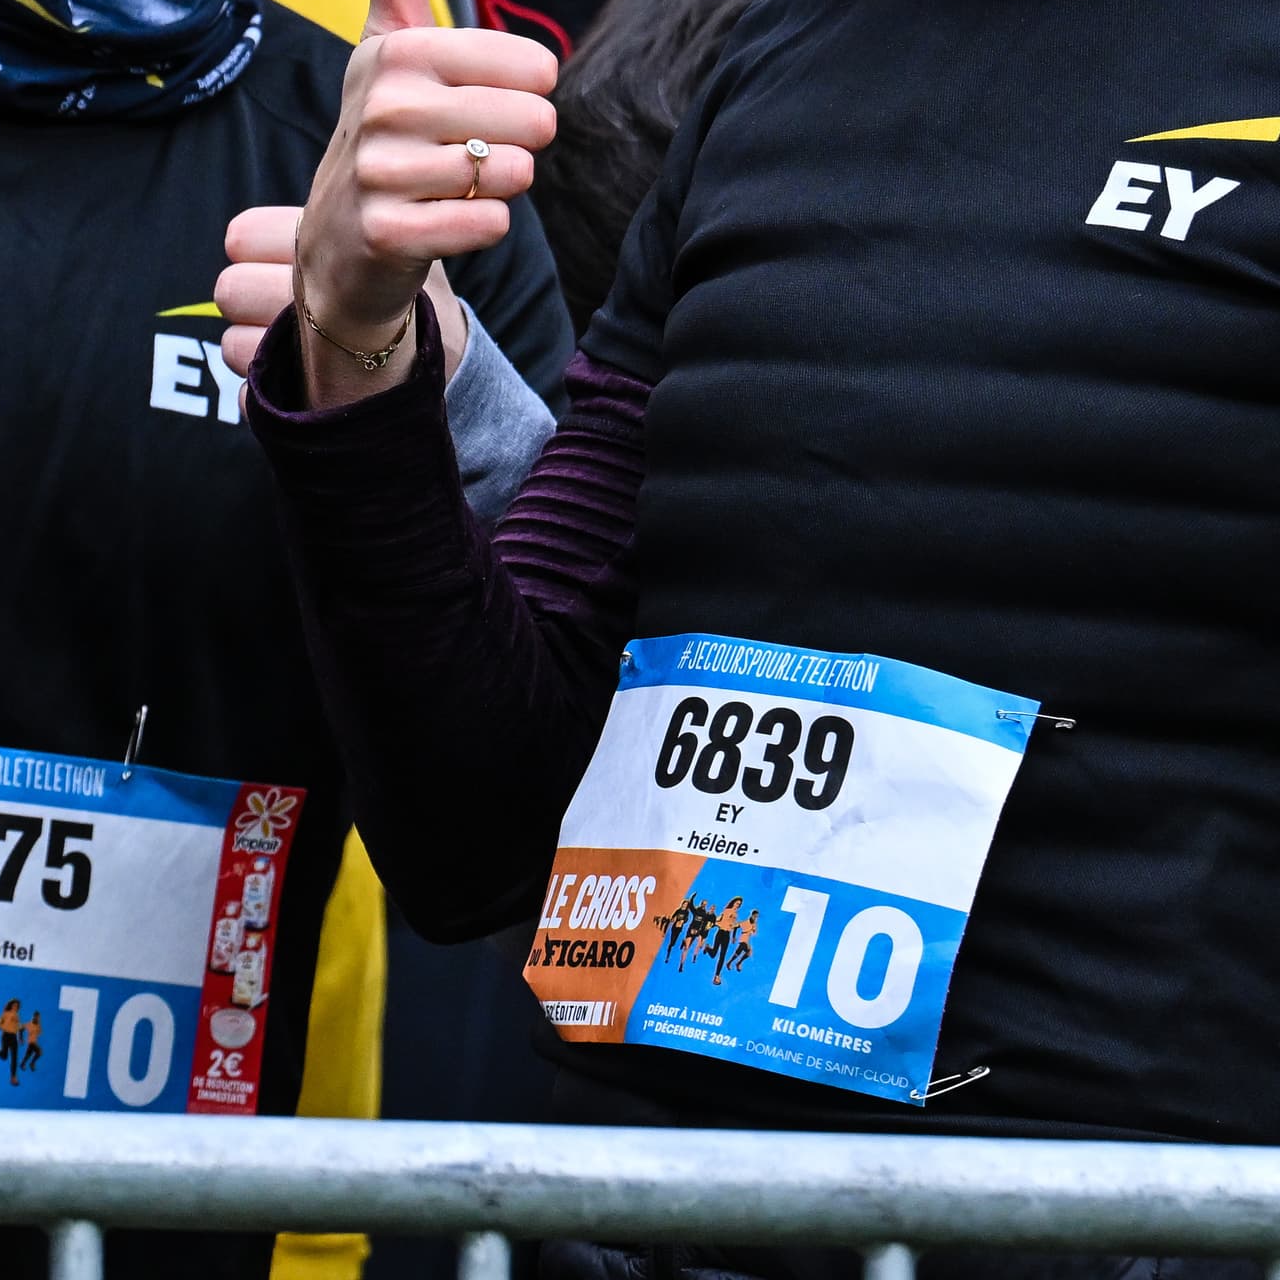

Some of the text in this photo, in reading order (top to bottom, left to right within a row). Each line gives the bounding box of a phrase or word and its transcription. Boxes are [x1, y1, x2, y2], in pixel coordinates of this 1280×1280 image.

[1085, 160, 1241, 241] EY
[150, 333, 247, 425] EY
[677, 641, 880, 693] #JECOURSPOURLETELETHON
[654, 696, 855, 811] 6839
[715, 802, 744, 824] EY
[687, 831, 749, 857] hélène
[538, 874, 657, 931] LE CROSS
[528, 934, 635, 969] DU FIGARO
[768, 885, 924, 1029] 10
[555, 1001, 588, 1021] ÉDITION
[646, 1002, 724, 1027] DÉPART À 11H30
[771, 1018, 873, 1054] KILOMÈTRES
[58, 984, 176, 1108] 10
[654, 1021, 708, 1041] DÉCEMBRE
[708, 1032, 738, 1048] 2024
[746, 1040, 805, 1065] DOMAINE
[806, 1055, 822, 1070] DE
[825, 1060, 909, 1089] SAINT-CLOUD
